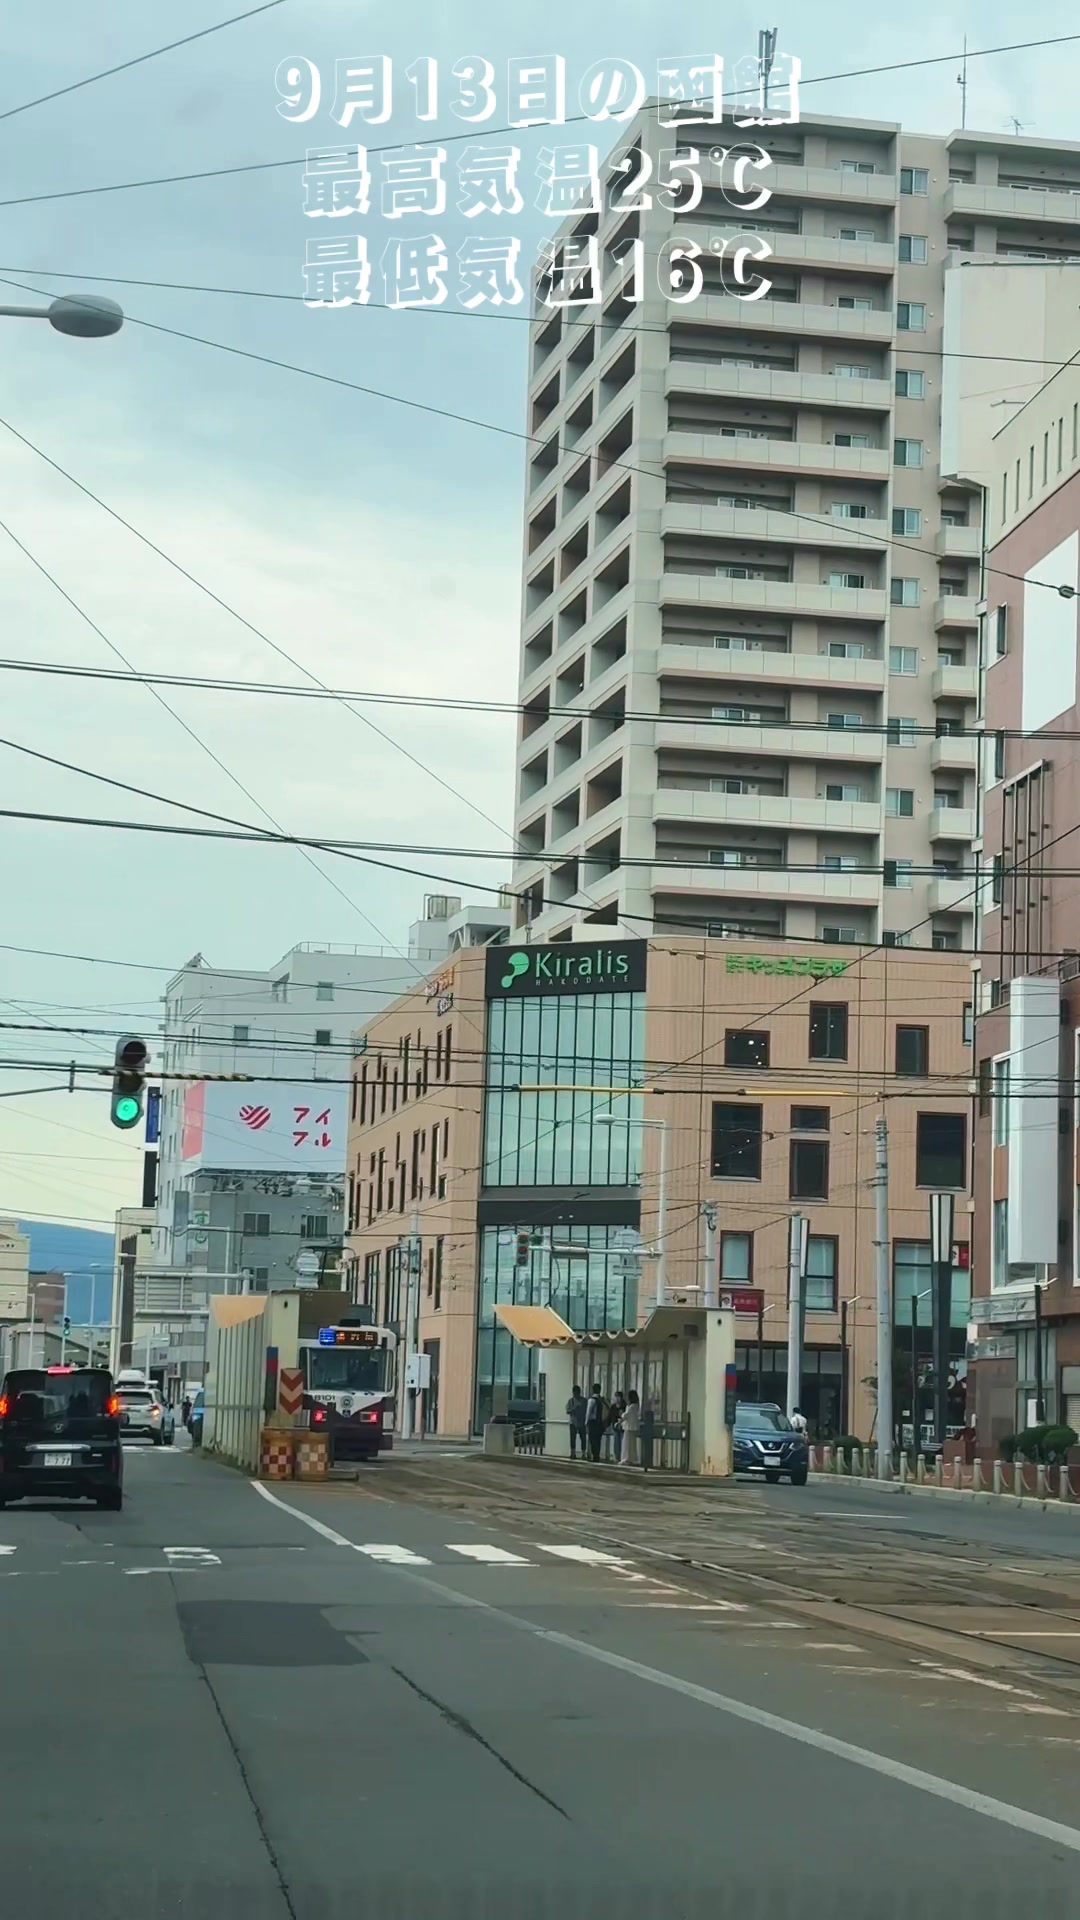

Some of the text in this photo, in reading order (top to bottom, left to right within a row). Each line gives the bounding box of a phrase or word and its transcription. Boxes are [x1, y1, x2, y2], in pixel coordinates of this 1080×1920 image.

[535, 949, 629, 977] Kiralis
[535, 976, 629, 986] HAKODATE
[293, 1107, 331, 1125] アイ
[292, 1131, 331, 1147] フル
